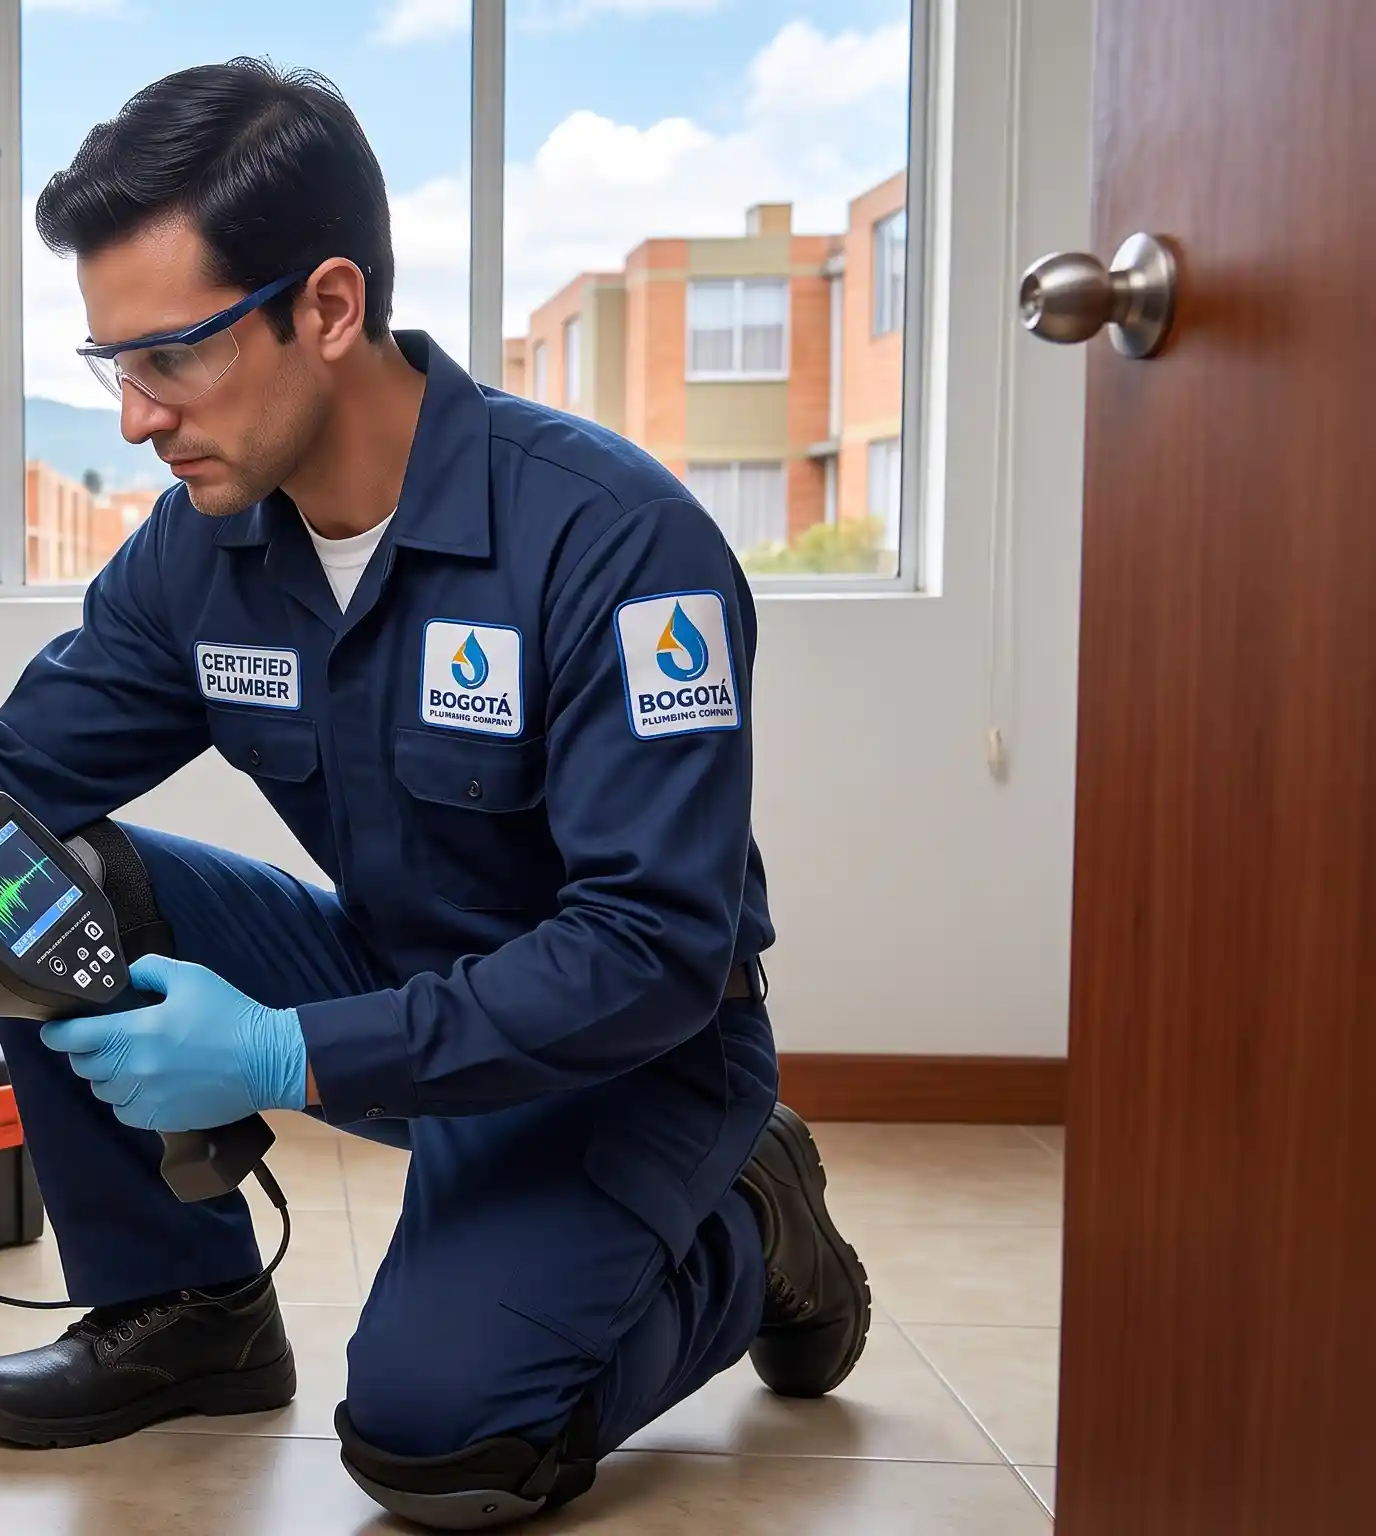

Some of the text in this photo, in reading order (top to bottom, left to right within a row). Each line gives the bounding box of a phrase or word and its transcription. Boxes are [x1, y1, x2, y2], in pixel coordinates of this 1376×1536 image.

[202, 652, 292, 677] CERTIFIED
[206, 673, 289, 700] PLUMBER
[638, 678, 732, 714] BOGOTÁ
[429, 689, 512, 717] BOGOTÁ
[472, 715, 513, 727] COMPANY
[641, 710, 697, 726] PLUMBING
